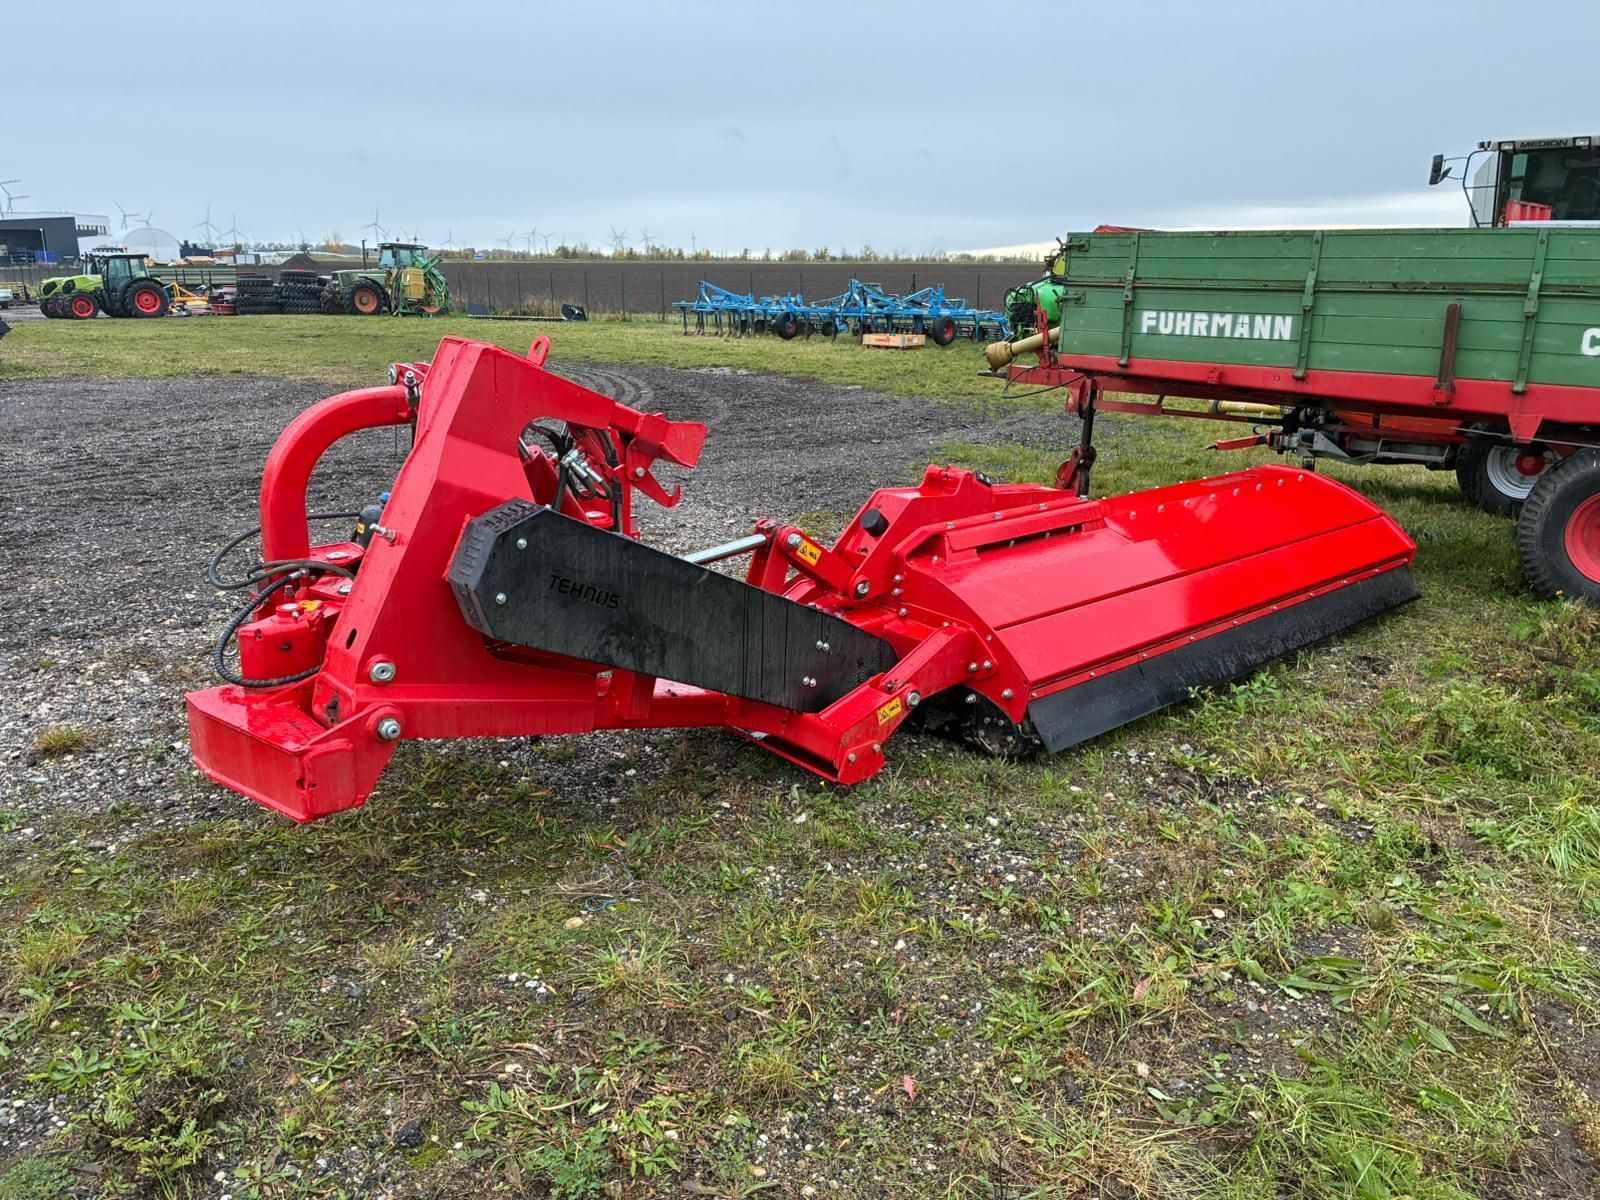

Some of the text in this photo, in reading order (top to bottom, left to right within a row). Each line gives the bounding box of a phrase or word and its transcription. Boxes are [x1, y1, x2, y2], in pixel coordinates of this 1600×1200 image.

[1520, 138, 1569, 149] MEDION
[1141, 310, 1293, 341] FUHRMANN
[549, 574, 621, 609] TEHNOS
